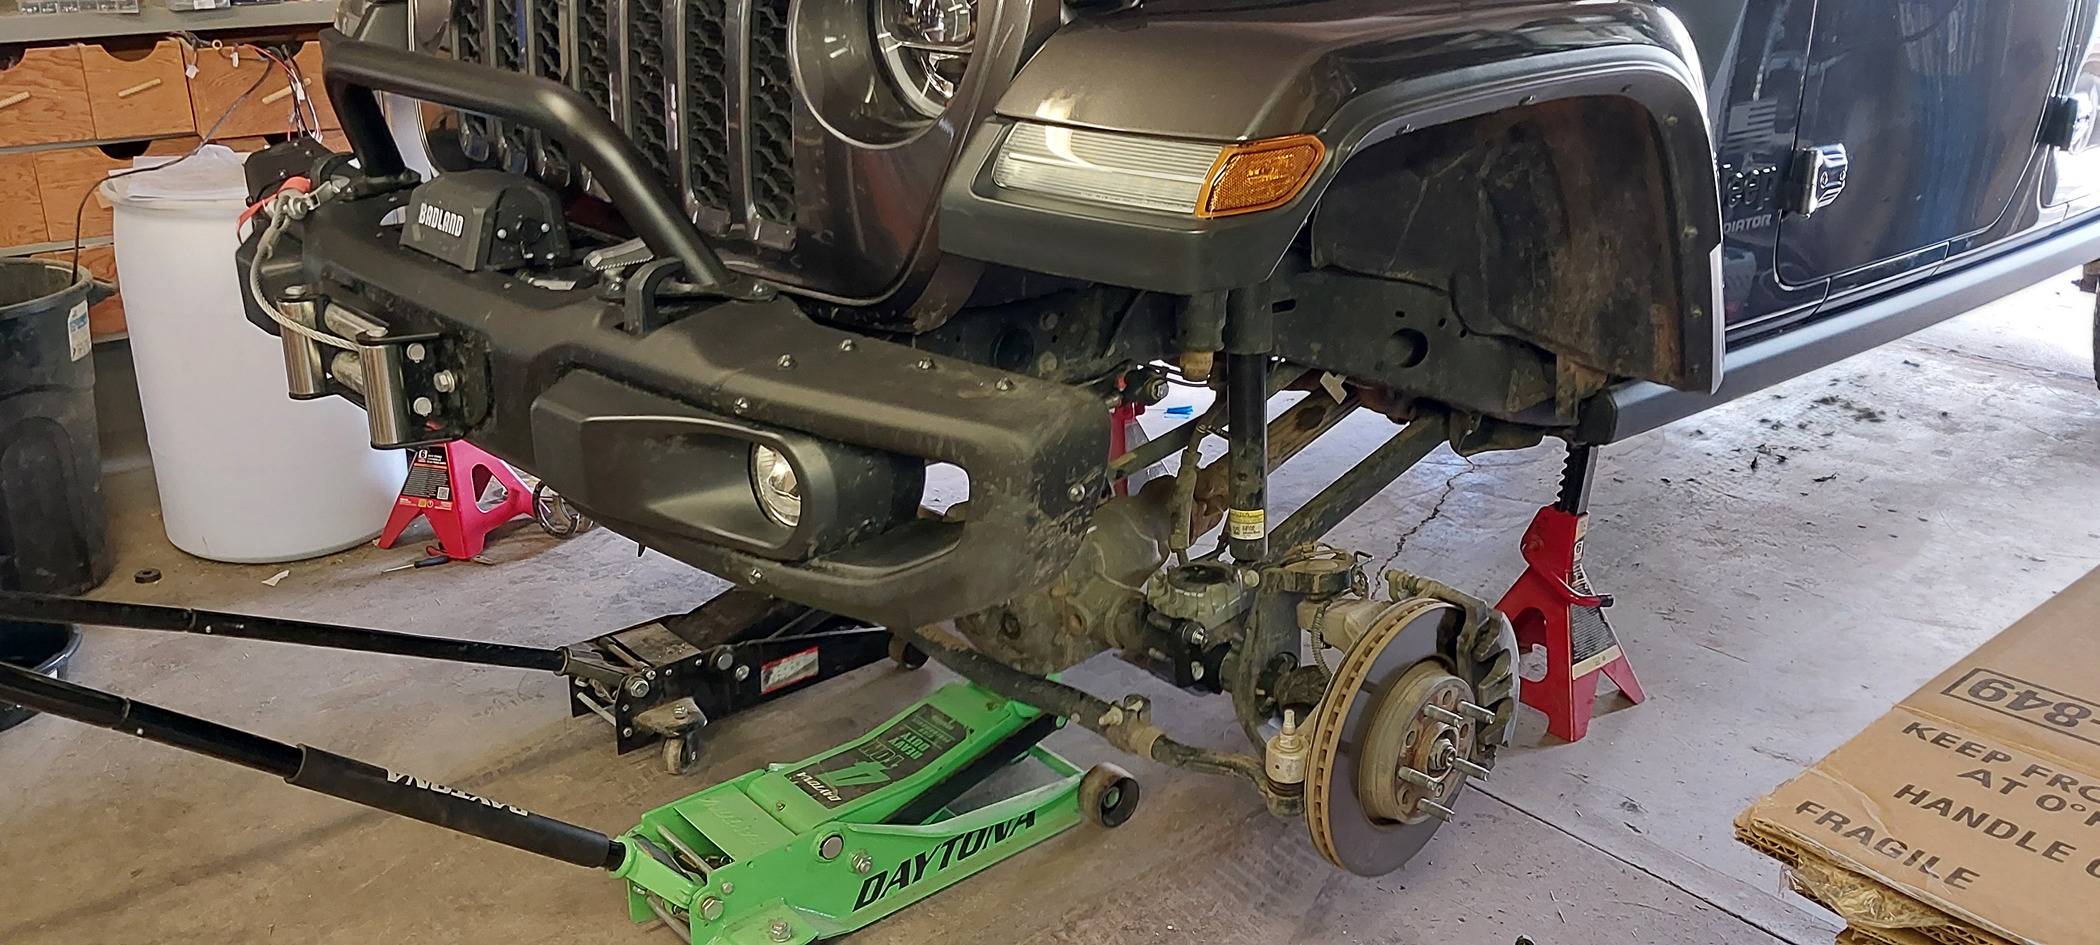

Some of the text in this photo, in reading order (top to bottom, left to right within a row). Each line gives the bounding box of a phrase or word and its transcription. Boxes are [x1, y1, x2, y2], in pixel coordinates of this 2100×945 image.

[419, 202, 464, 237] BADLAND
[1724, 214, 1772, 234] DIATOR
[1902, 722, 2012, 763] KEEP
[796, 772, 841, 802] DAYTONA
[1957, 769, 2028, 794] AT
[1893, 784, 2077, 863] HANDLE
[853, 810, 1036, 912] DAYTONA
[1795, 800, 1981, 890] FRAGILE
